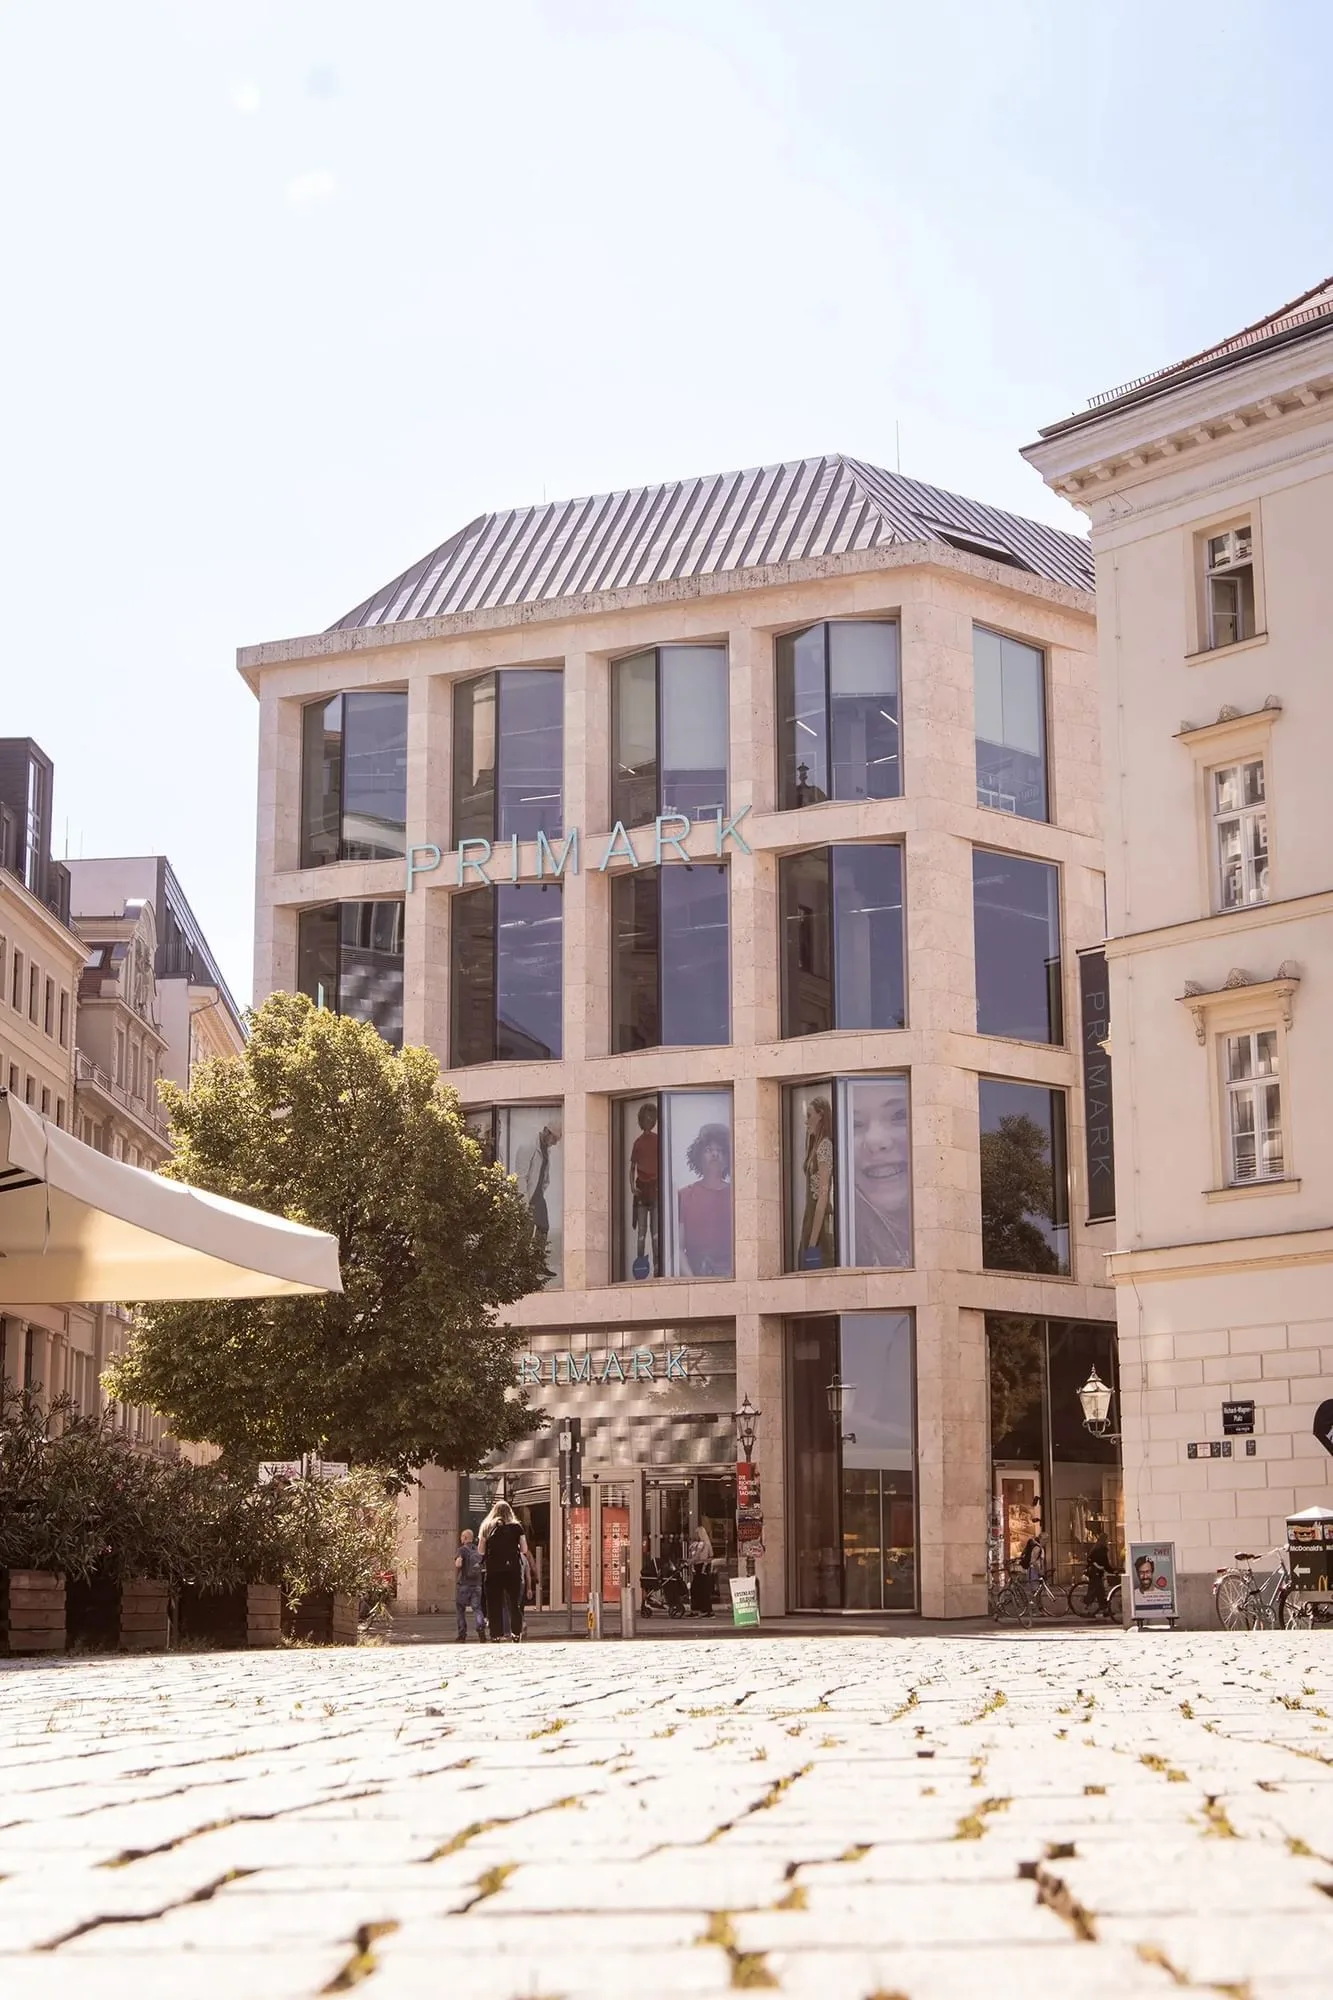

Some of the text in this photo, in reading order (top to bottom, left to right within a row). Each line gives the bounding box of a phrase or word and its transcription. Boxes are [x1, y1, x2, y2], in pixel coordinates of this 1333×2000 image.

[405, 804, 753, 894] PRIMARK
[1085, 991, 1111, 1179] PRIMARK
[520, 1349, 689, 1385] RIMARK
[1289, 1544, 1324, 1552] McDonald's
